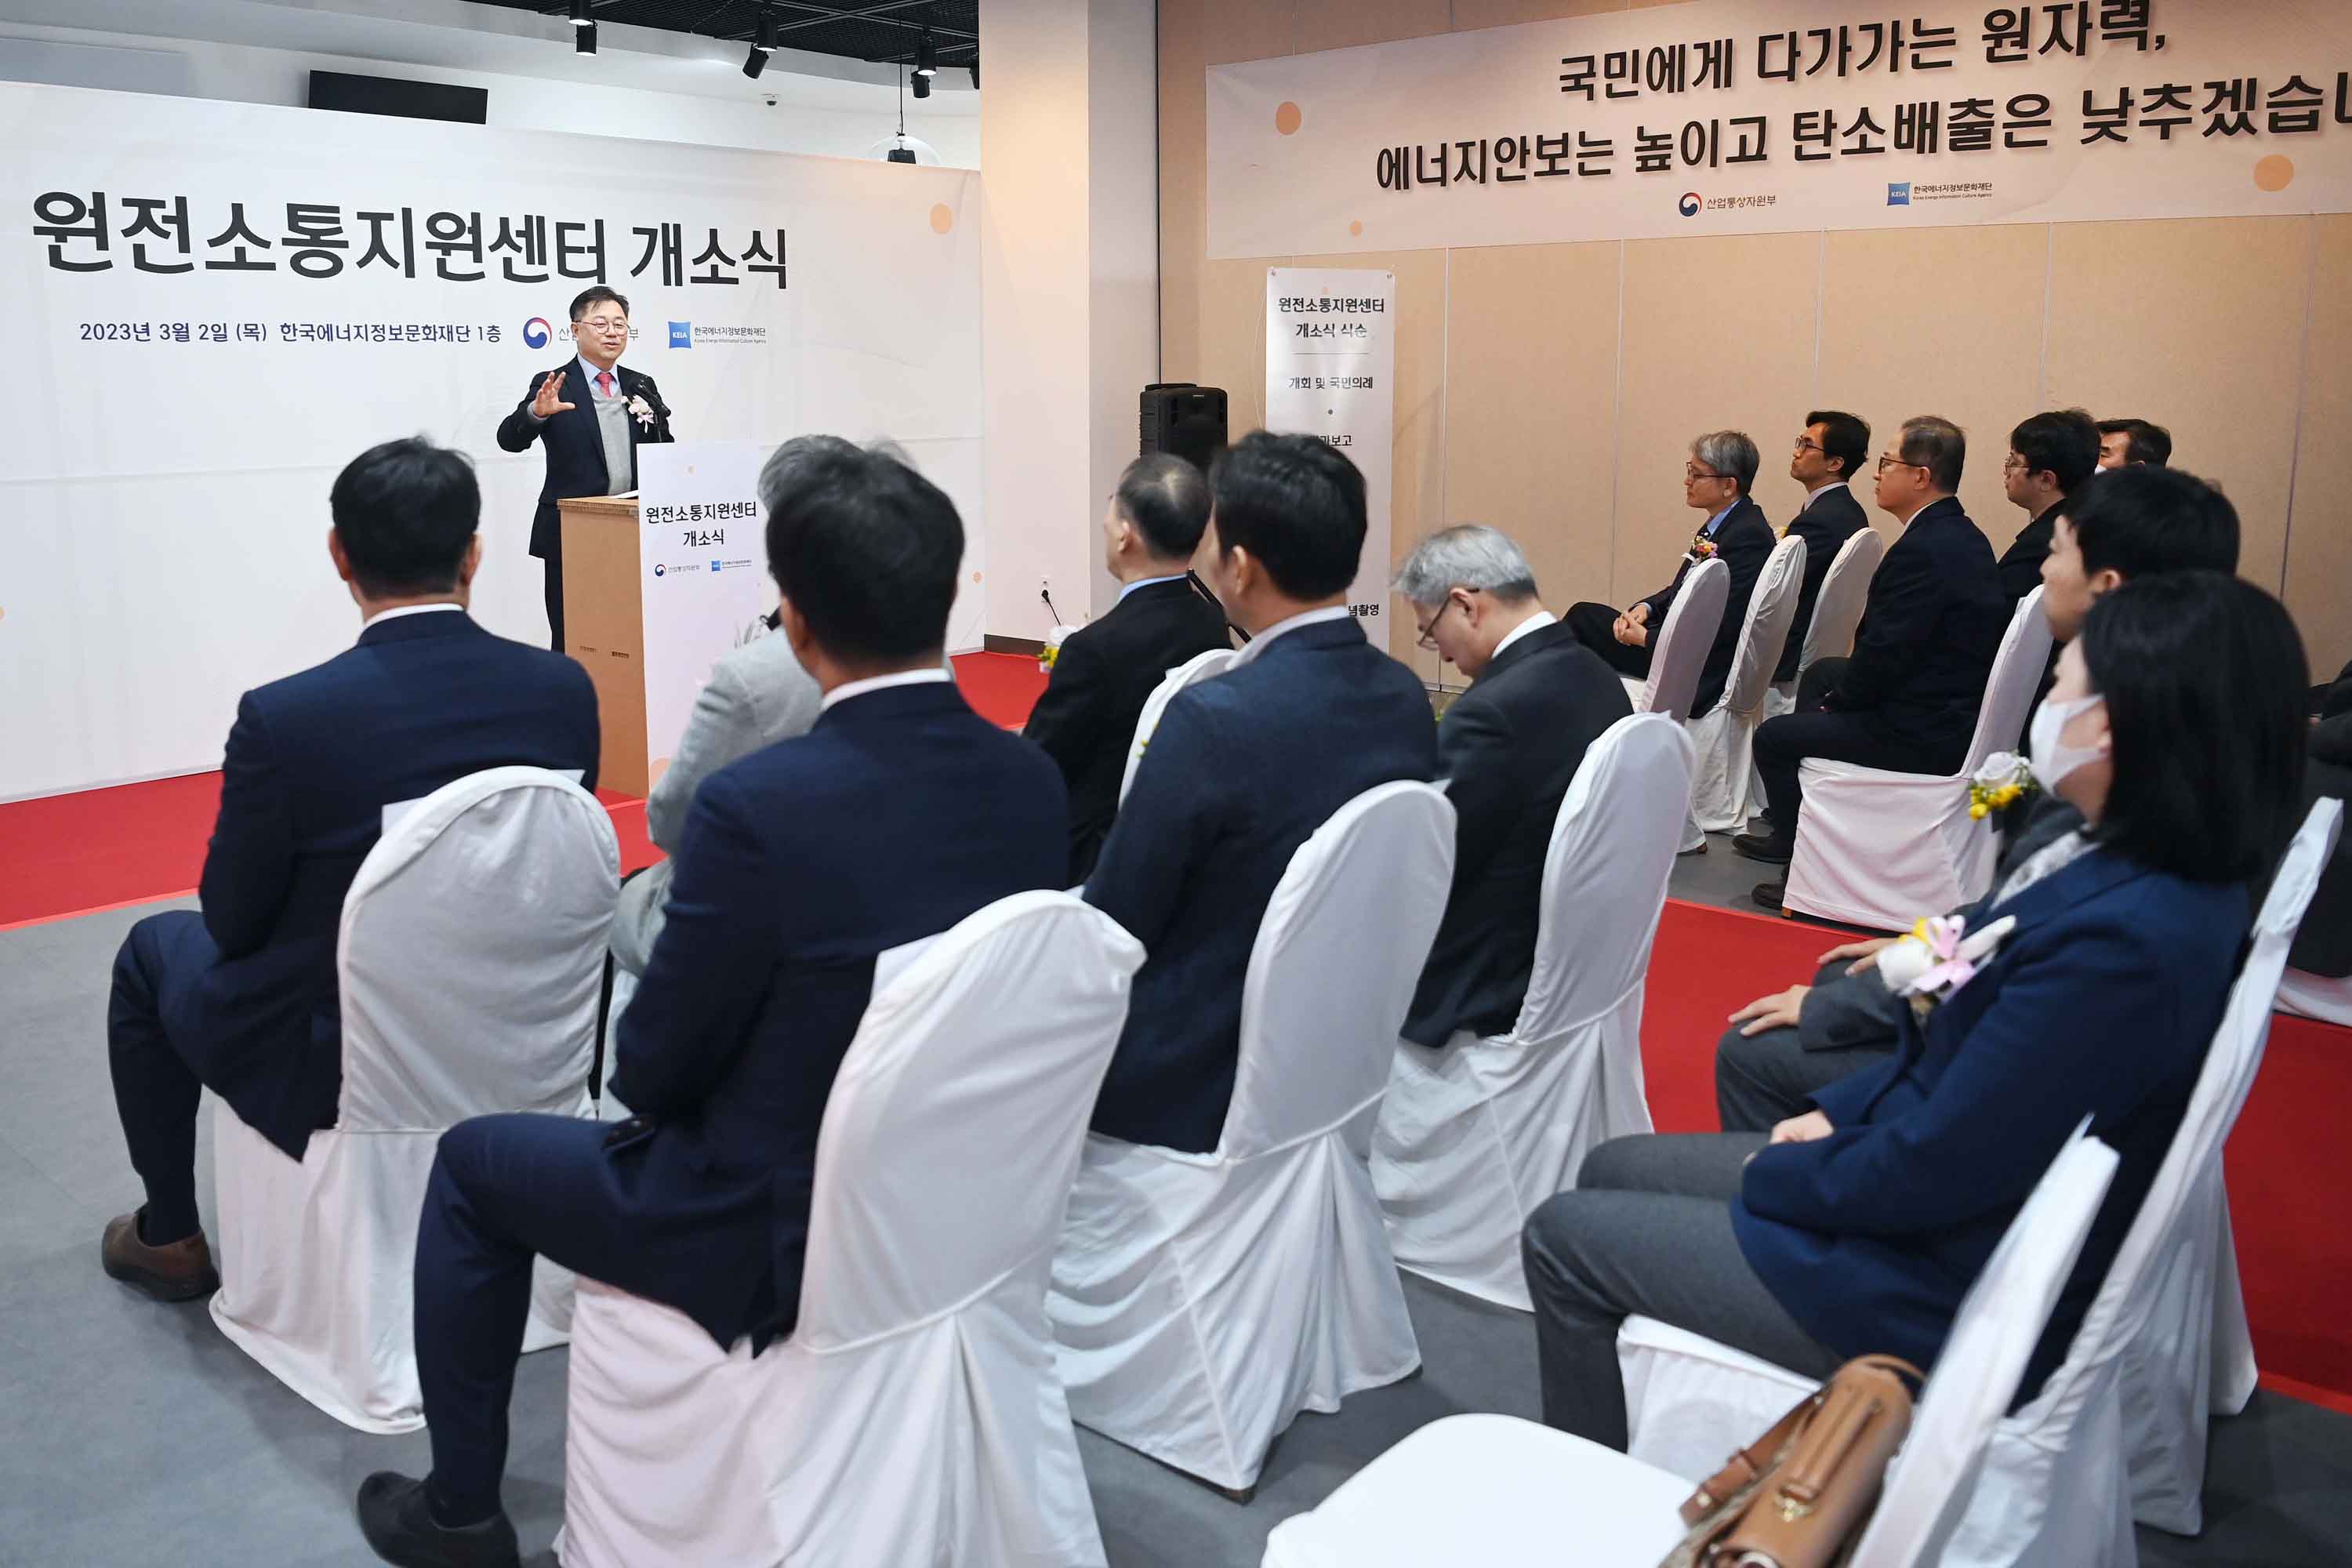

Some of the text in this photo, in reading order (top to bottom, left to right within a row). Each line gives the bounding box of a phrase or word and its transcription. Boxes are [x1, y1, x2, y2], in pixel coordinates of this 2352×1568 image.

[1559, 0, 2166, 102] 국민에게 다가가는 원자력,
[1376, 130, 1614, 191] 에너지안보는
[1634, 115, 1768, 173] 높이고
[1793, 93, 2053, 162] 탄소배출은
[1913, 182, 1992, 194] 한국에너지정보문화재단
[1707, 195, 1776, 209] 산업통상자원부
[32, 191, 787, 289] 원전소통지원센터 개소식
[1279, 297, 1385, 314] 원전소통지원센터
[80, 321, 502, 343] 2023년 3월 2일 (목) 한국에너지정보문화재단 1층
[695, 326, 766, 336] 한국에너지정보문화재단
[1295, 322, 1368, 338] 개소식 식순
[1288, 376, 1374, 390] 개회 및 국민의례
[1314, 434, 1352, 447] 과보고
[646, 501, 757, 524] 원전소통지원센터
[683, 528, 724, 547] 개소식
[1348, 603, 1379, 617] 념촬영
